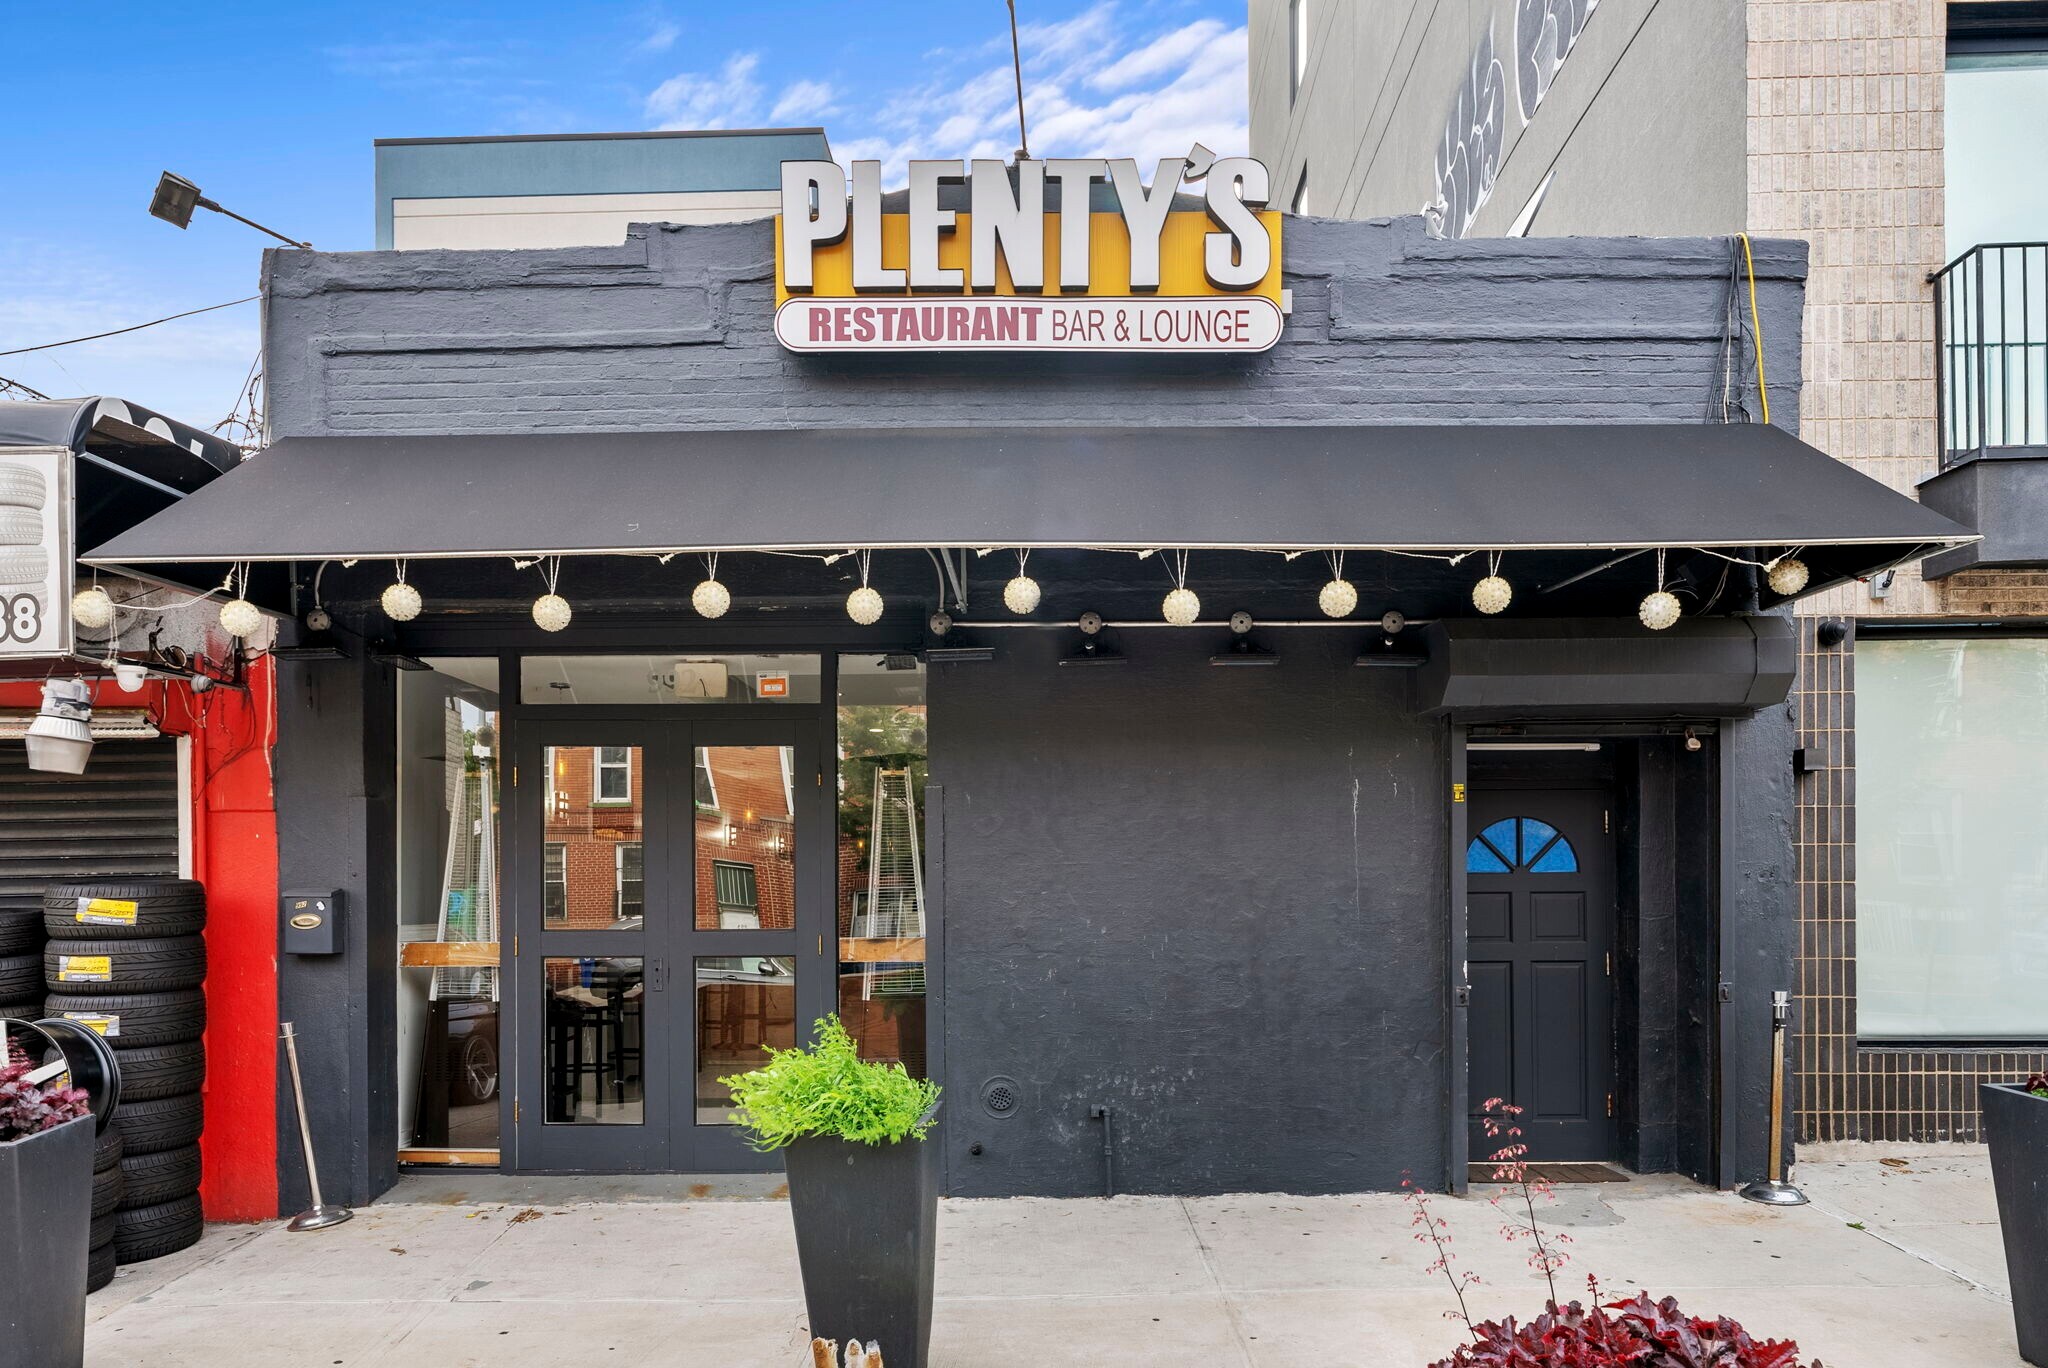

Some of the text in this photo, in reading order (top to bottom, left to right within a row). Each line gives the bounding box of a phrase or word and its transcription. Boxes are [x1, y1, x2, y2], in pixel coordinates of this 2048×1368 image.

[781, 142, 1271, 293] PLENTY'S
[808, 306, 1251, 343] RESTAURANT BAR & LOUNGE
